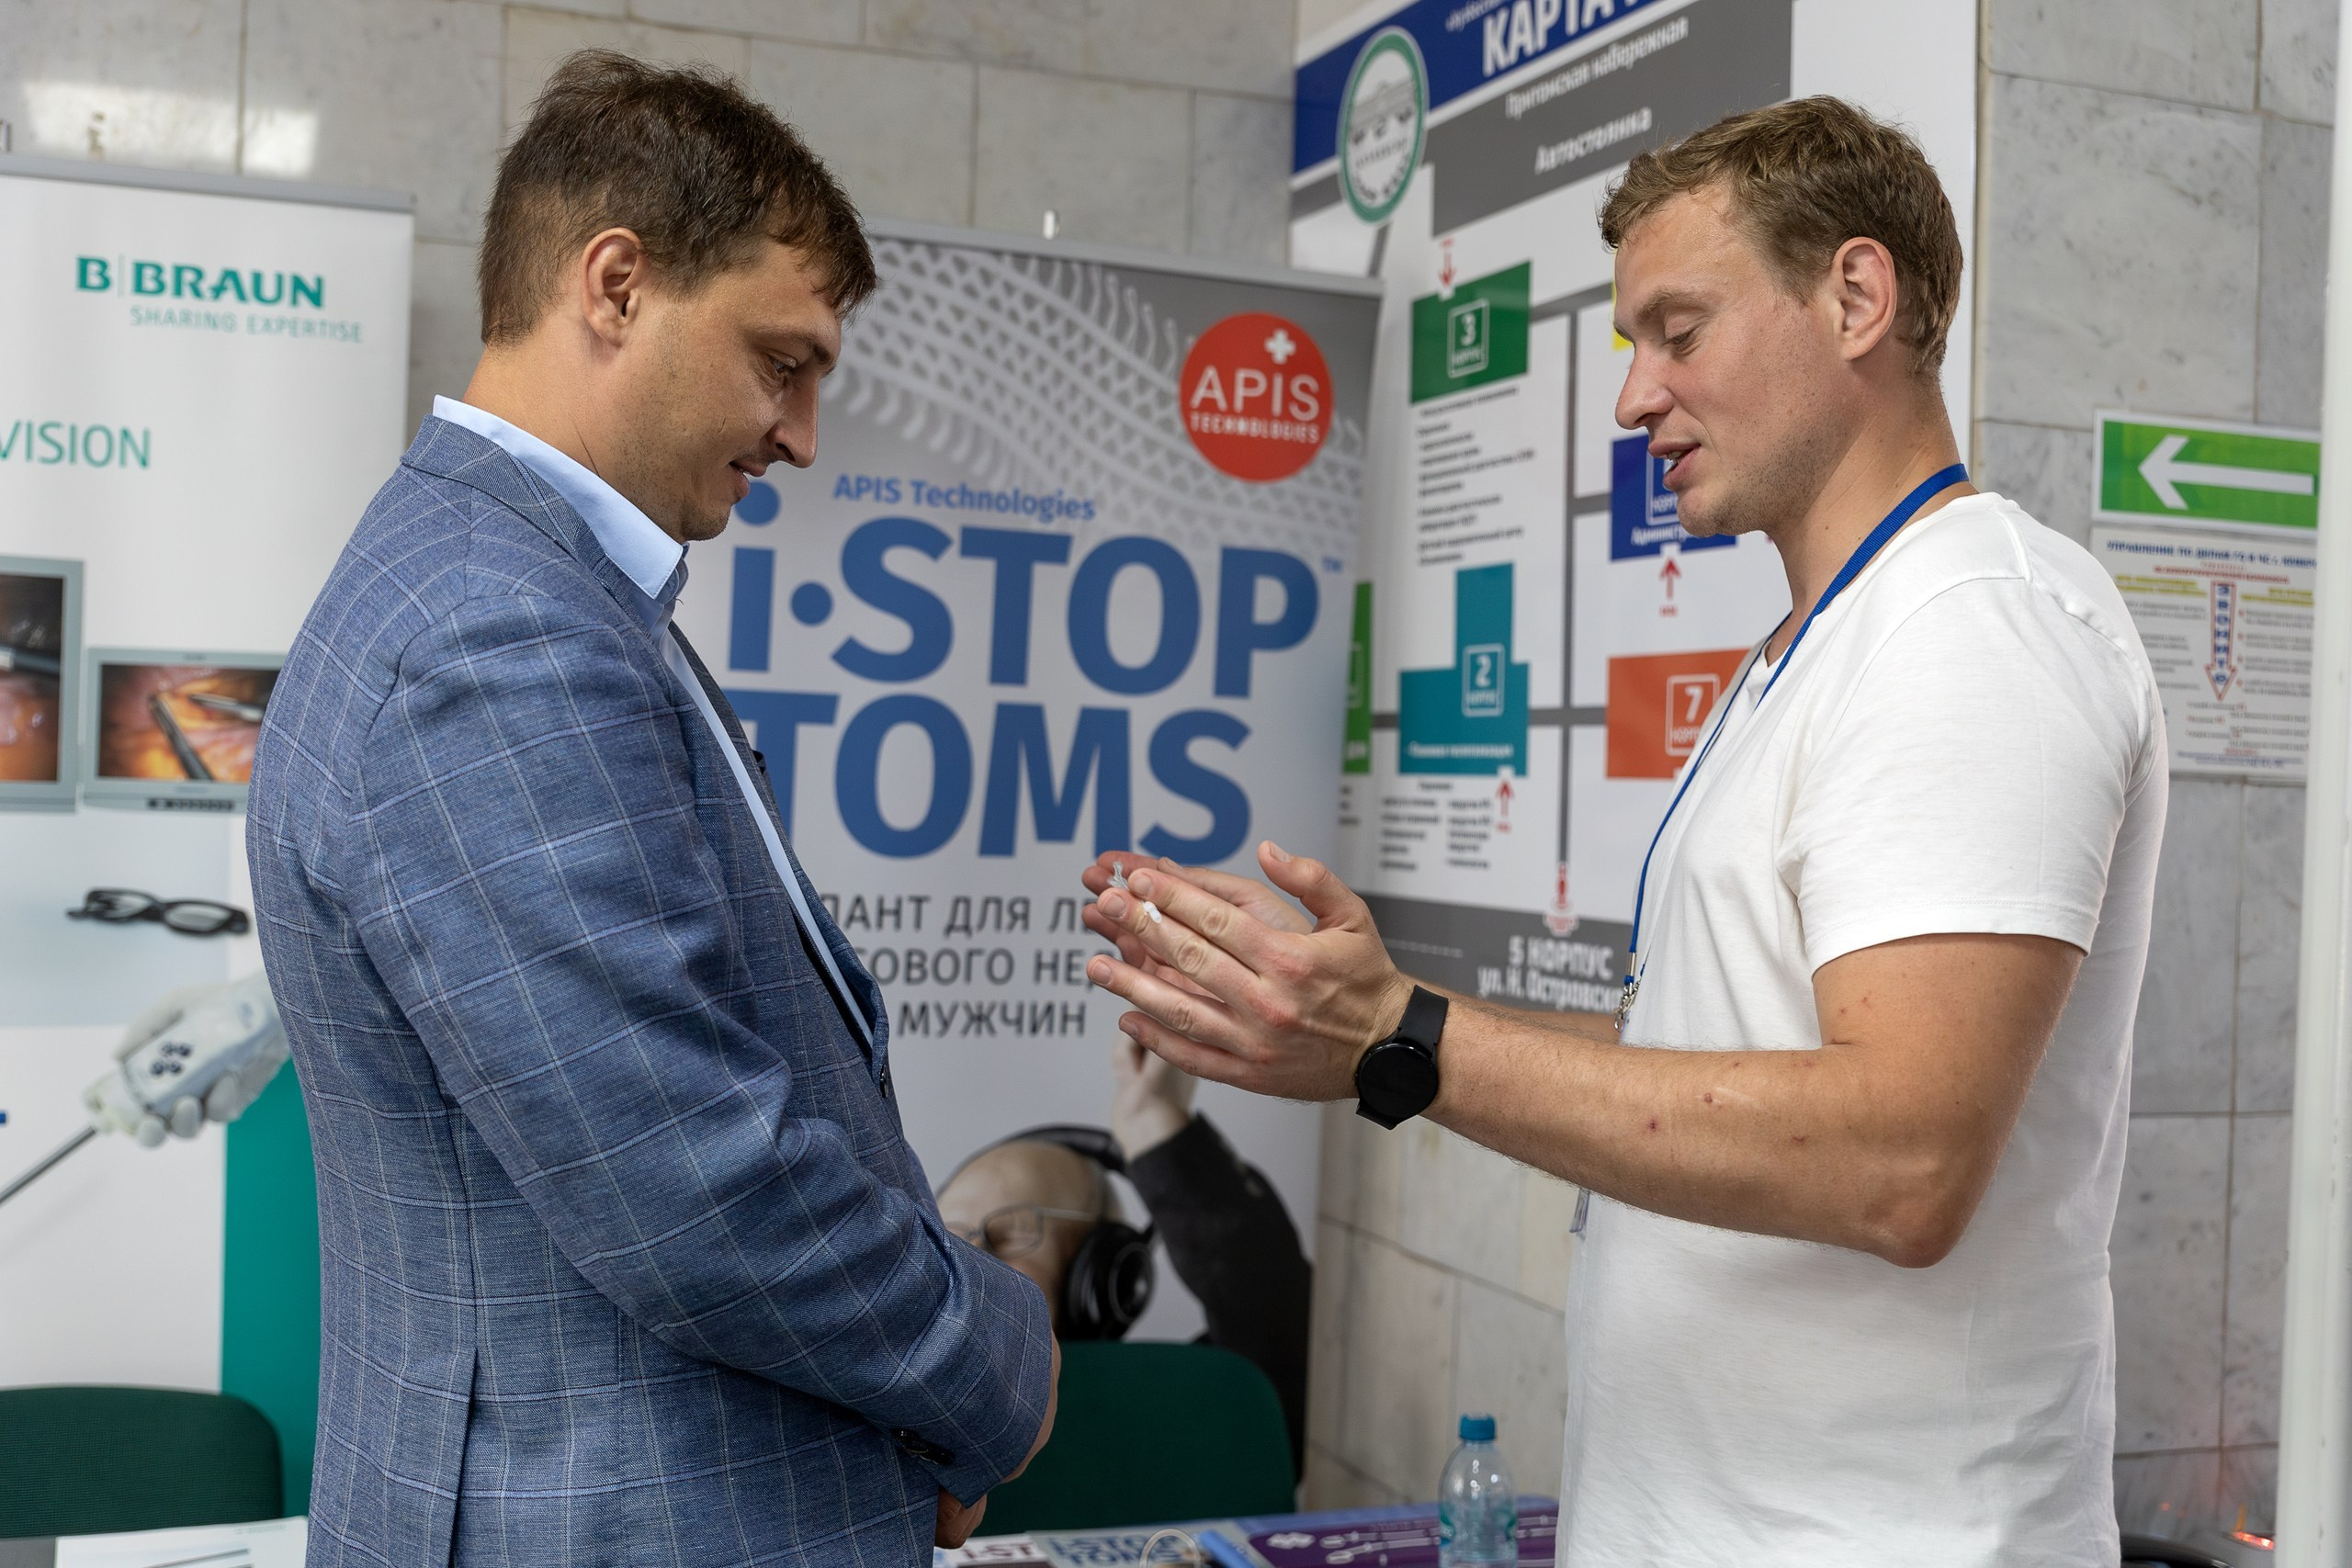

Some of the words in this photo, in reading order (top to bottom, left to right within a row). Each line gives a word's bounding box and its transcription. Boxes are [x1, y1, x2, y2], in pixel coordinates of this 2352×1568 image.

[1533, 106, 1653, 175] Автостоянка
[75, 254, 111, 293] B
[130, 258, 325, 309] BRAUN
[130, 305, 238, 333] SHARING
[246, 313, 365, 344] EXPERTISE
[1190, 364, 1320, 423] APIS
[1189, 411, 1320, 445] TECHNOLOGIES
[832, 472, 902, 504] APIS
[910, 478, 1097, 525] Technologies
[1476, 654, 1491, 688] 2
[1684, 685, 1704, 723] 7
[718, 688, 1253, 865] TOMS
[944, 895, 1031, 939] ДЛЯ
[855, 947, 1014, 987] ОВОГО
[1527, 937, 1614, 981] КОРПУС
[897, 1000, 1087, 1038] МУЖЧИН
